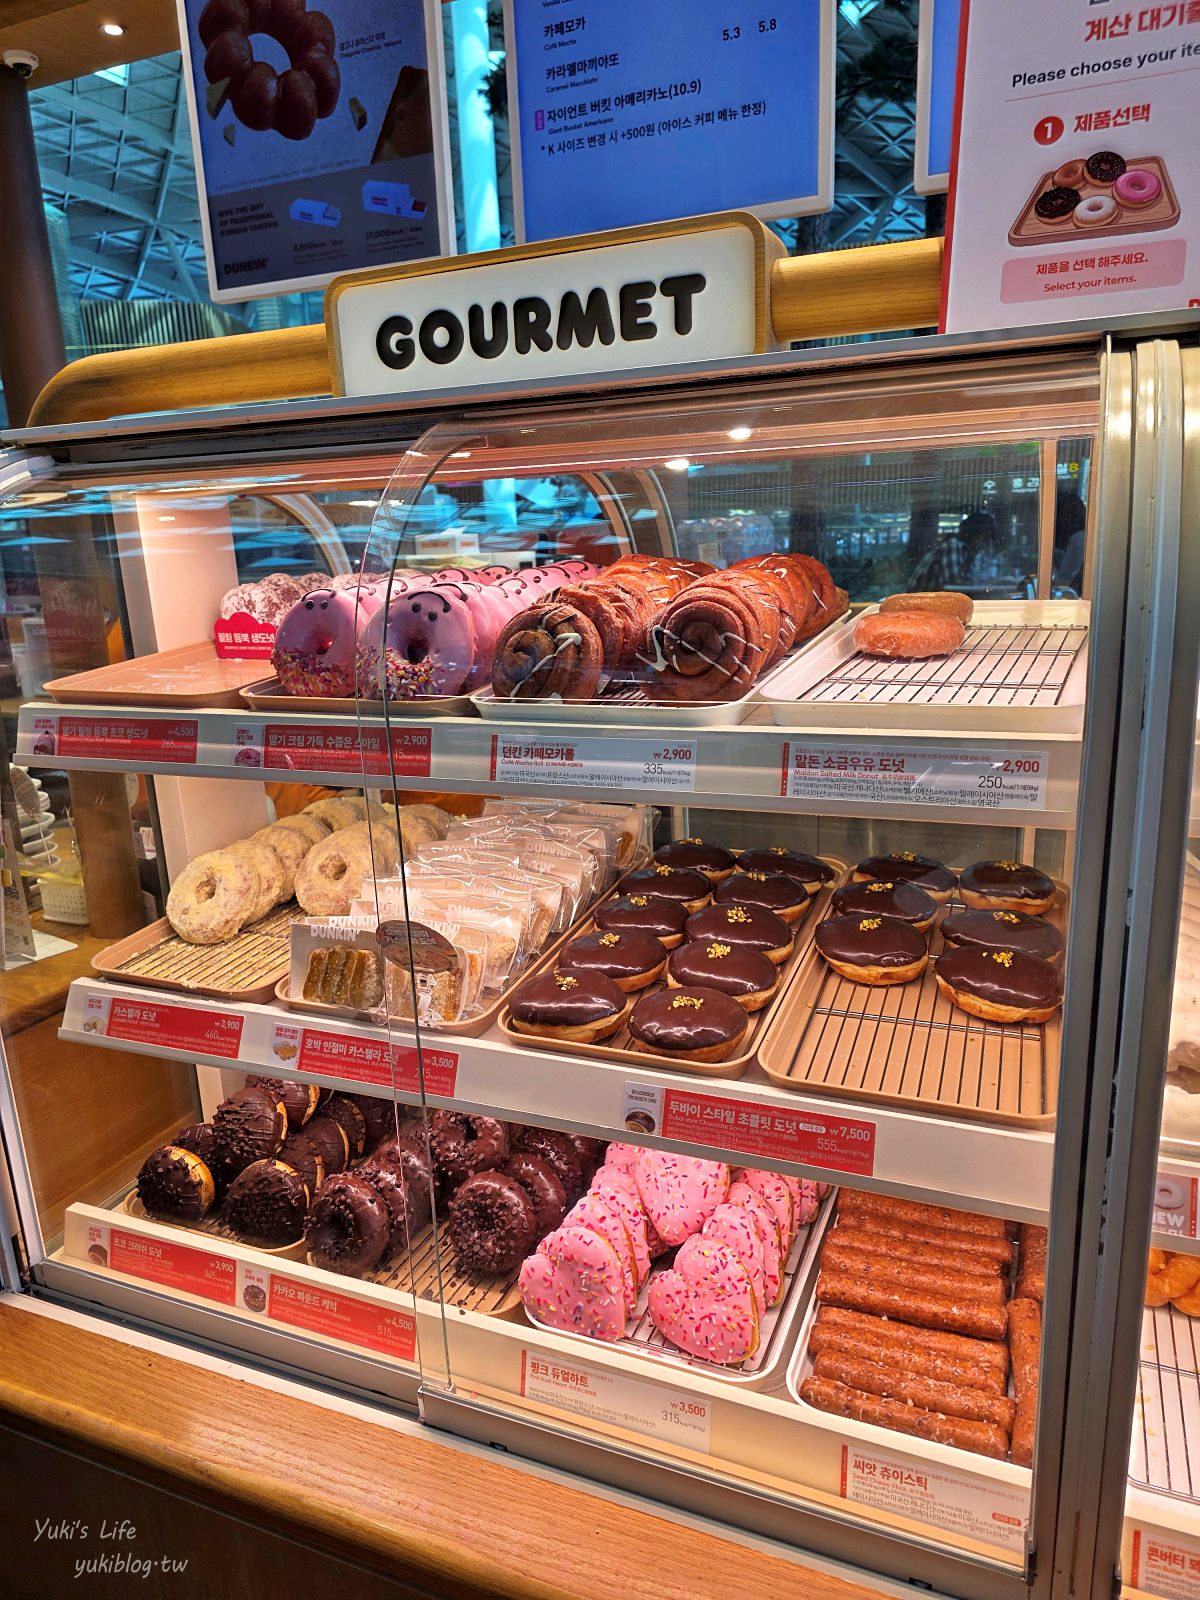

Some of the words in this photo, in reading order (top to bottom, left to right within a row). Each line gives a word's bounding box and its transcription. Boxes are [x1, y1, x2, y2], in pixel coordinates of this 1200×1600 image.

[543, 16, 586, 38] 카페모카
[722, 26, 741, 41] 5.3
[758, 18, 777, 34] 5.8
[1084, 12, 1132, 42] 계산
[1012, 68, 1066, 88] Please
[1070, 56, 1132, 77] choose
[1137, 48, 1177, 69] your
[547, 103, 588, 123] 자이언트
[590, 97, 612, 113] 버킷
[1073, 103, 1151, 134] 제품선택
[557, 138, 585, 153] 사이즈
[609, 130, 618, 143] 시
[620, 123, 655, 140] +500원
[694, 111, 715, 126] 커피
[1035, 260, 1070, 276] 제품을
[1072, 257, 1095, 272] 선택
[1097, 252, 1148, 269] 해주세요.
[1043, 281, 1076, 293] Select
[1078, 279, 1102, 291] your
[1103, 275, 1137, 286] items.
[375, 273, 707, 370] GOURMET
[269, 734, 286, 746] 딸기
[307, 735, 324, 747] 가득
[502, 746, 522, 759] 던킨
[523, 747, 575, 761] 카페모카롤
[795, 754, 821, 769] 말돈
[823, 756, 875, 771] 소금우유
[878, 758, 905, 773] 도넛
[820, 770, 841, 778] Salted
[857, 772, 879, 780] Donut
[978, 775, 1003, 789] 250
[310, 924, 360, 942] DUNKIN'
[205, 1029, 219, 1040] 460
[305, 1039, 321, 1051] 호박
[323, 1042, 347, 1055] 인절미
[348, 1045, 382, 1061] 카스텔라
[669, 1100, 701, 1118] 두바이
[703, 1106, 736, 1124] 스타일
[738, 1112, 771, 1131] 초콜릿
[773, 1118, 797, 1134] 도넛
[699, 1119, 729, 1130] Chocolate
[729, 1124, 747, 1133] Donut
[817, 1137, 837, 1152] 555
[273, 1283, 296, 1299] 카카오
[297, 1291, 320, 1307] 파운드
[377, 1325, 392, 1337] 515
[530, 1361, 549, 1376] 핑크
[551, 1366, 589, 1388] 듀얼하트
[661, 1409, 680, 1424] 315
[853, 1459, 877, 1477] 씨앗
[879, 1466, 928, 1491] 츄이스틱
[1146, 1546, 1185, 1570] 콘버터
